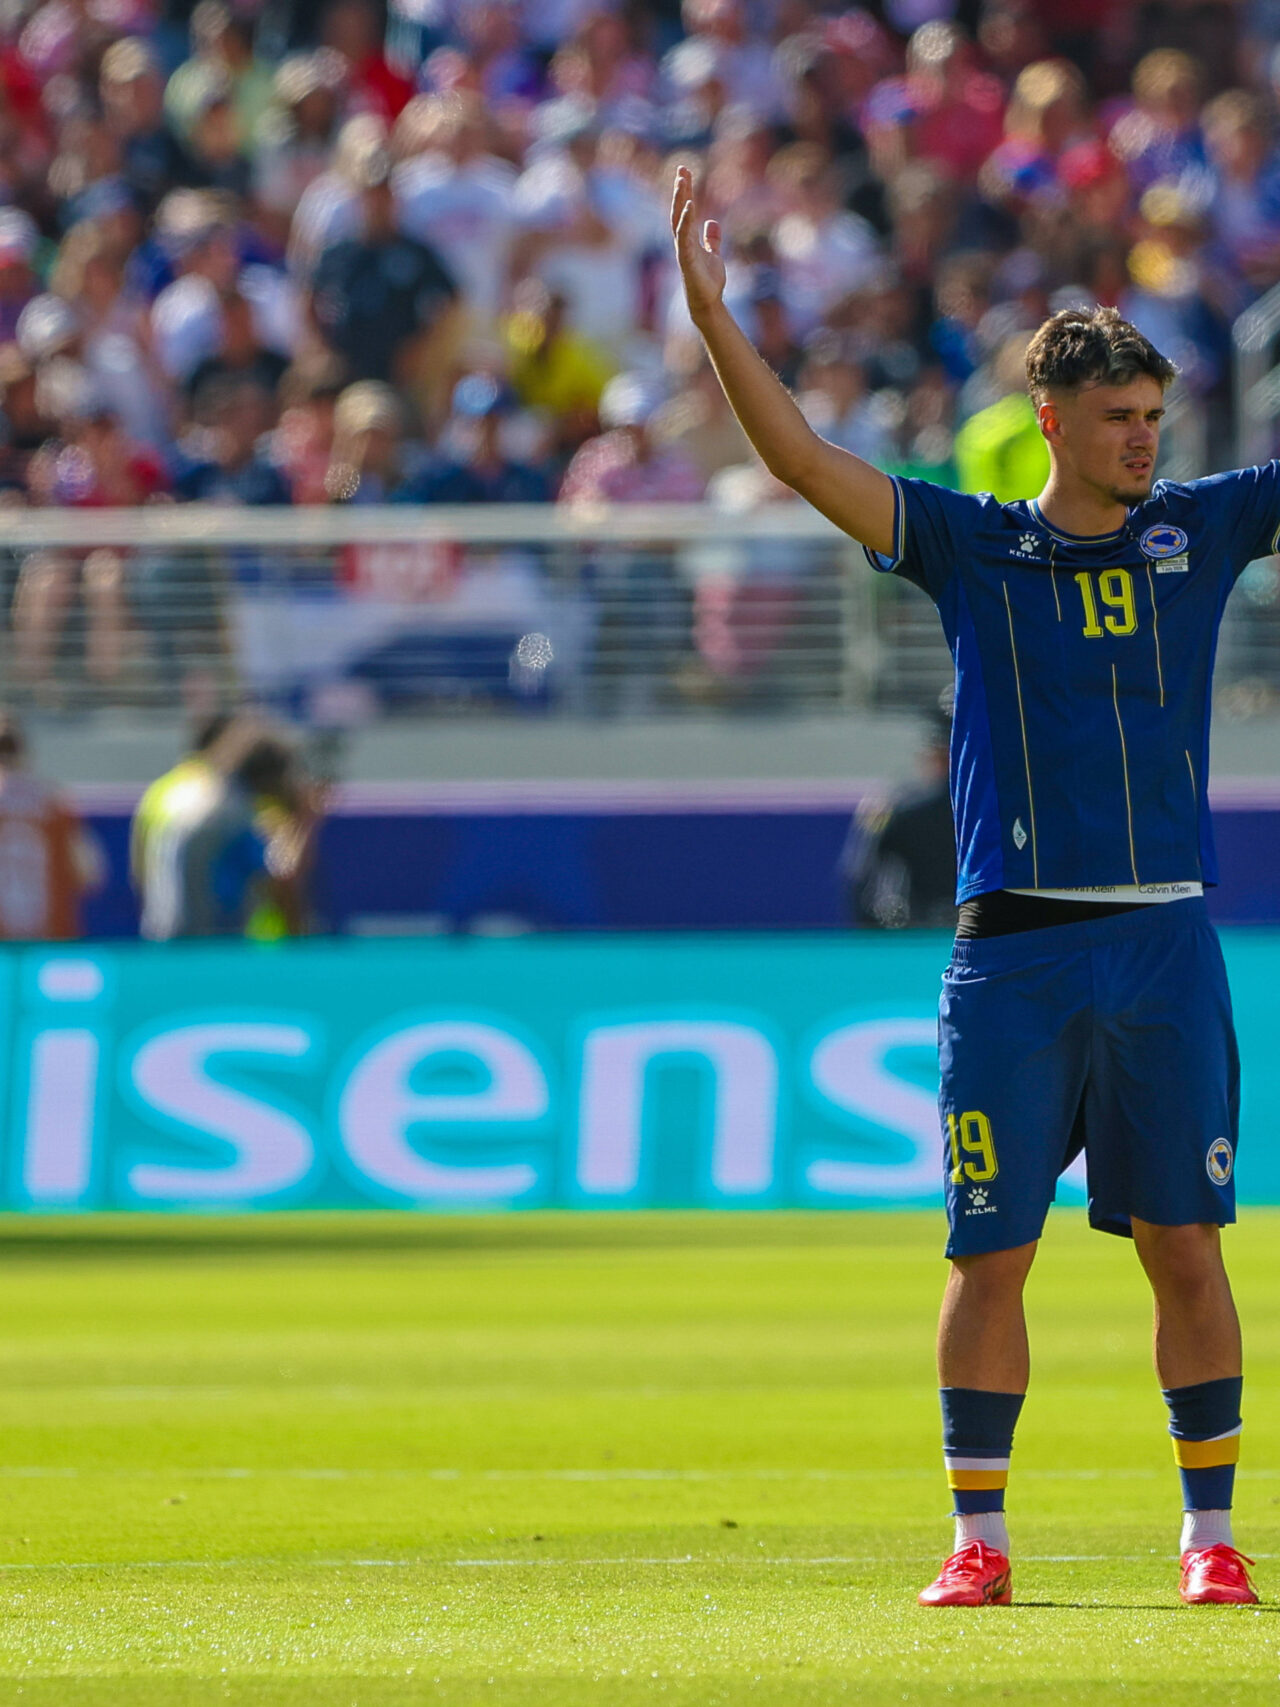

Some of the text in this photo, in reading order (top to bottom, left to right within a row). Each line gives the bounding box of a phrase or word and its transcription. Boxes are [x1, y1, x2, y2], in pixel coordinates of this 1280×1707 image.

[1074, 568, 1138, 638] 19
[1138, 884, 1191, 894] Calvin Klein
[24, 958, 944, 1201] isens
[947, 1110, 999, 1184] 19
[964, 1206, 998, 1216] KELME
